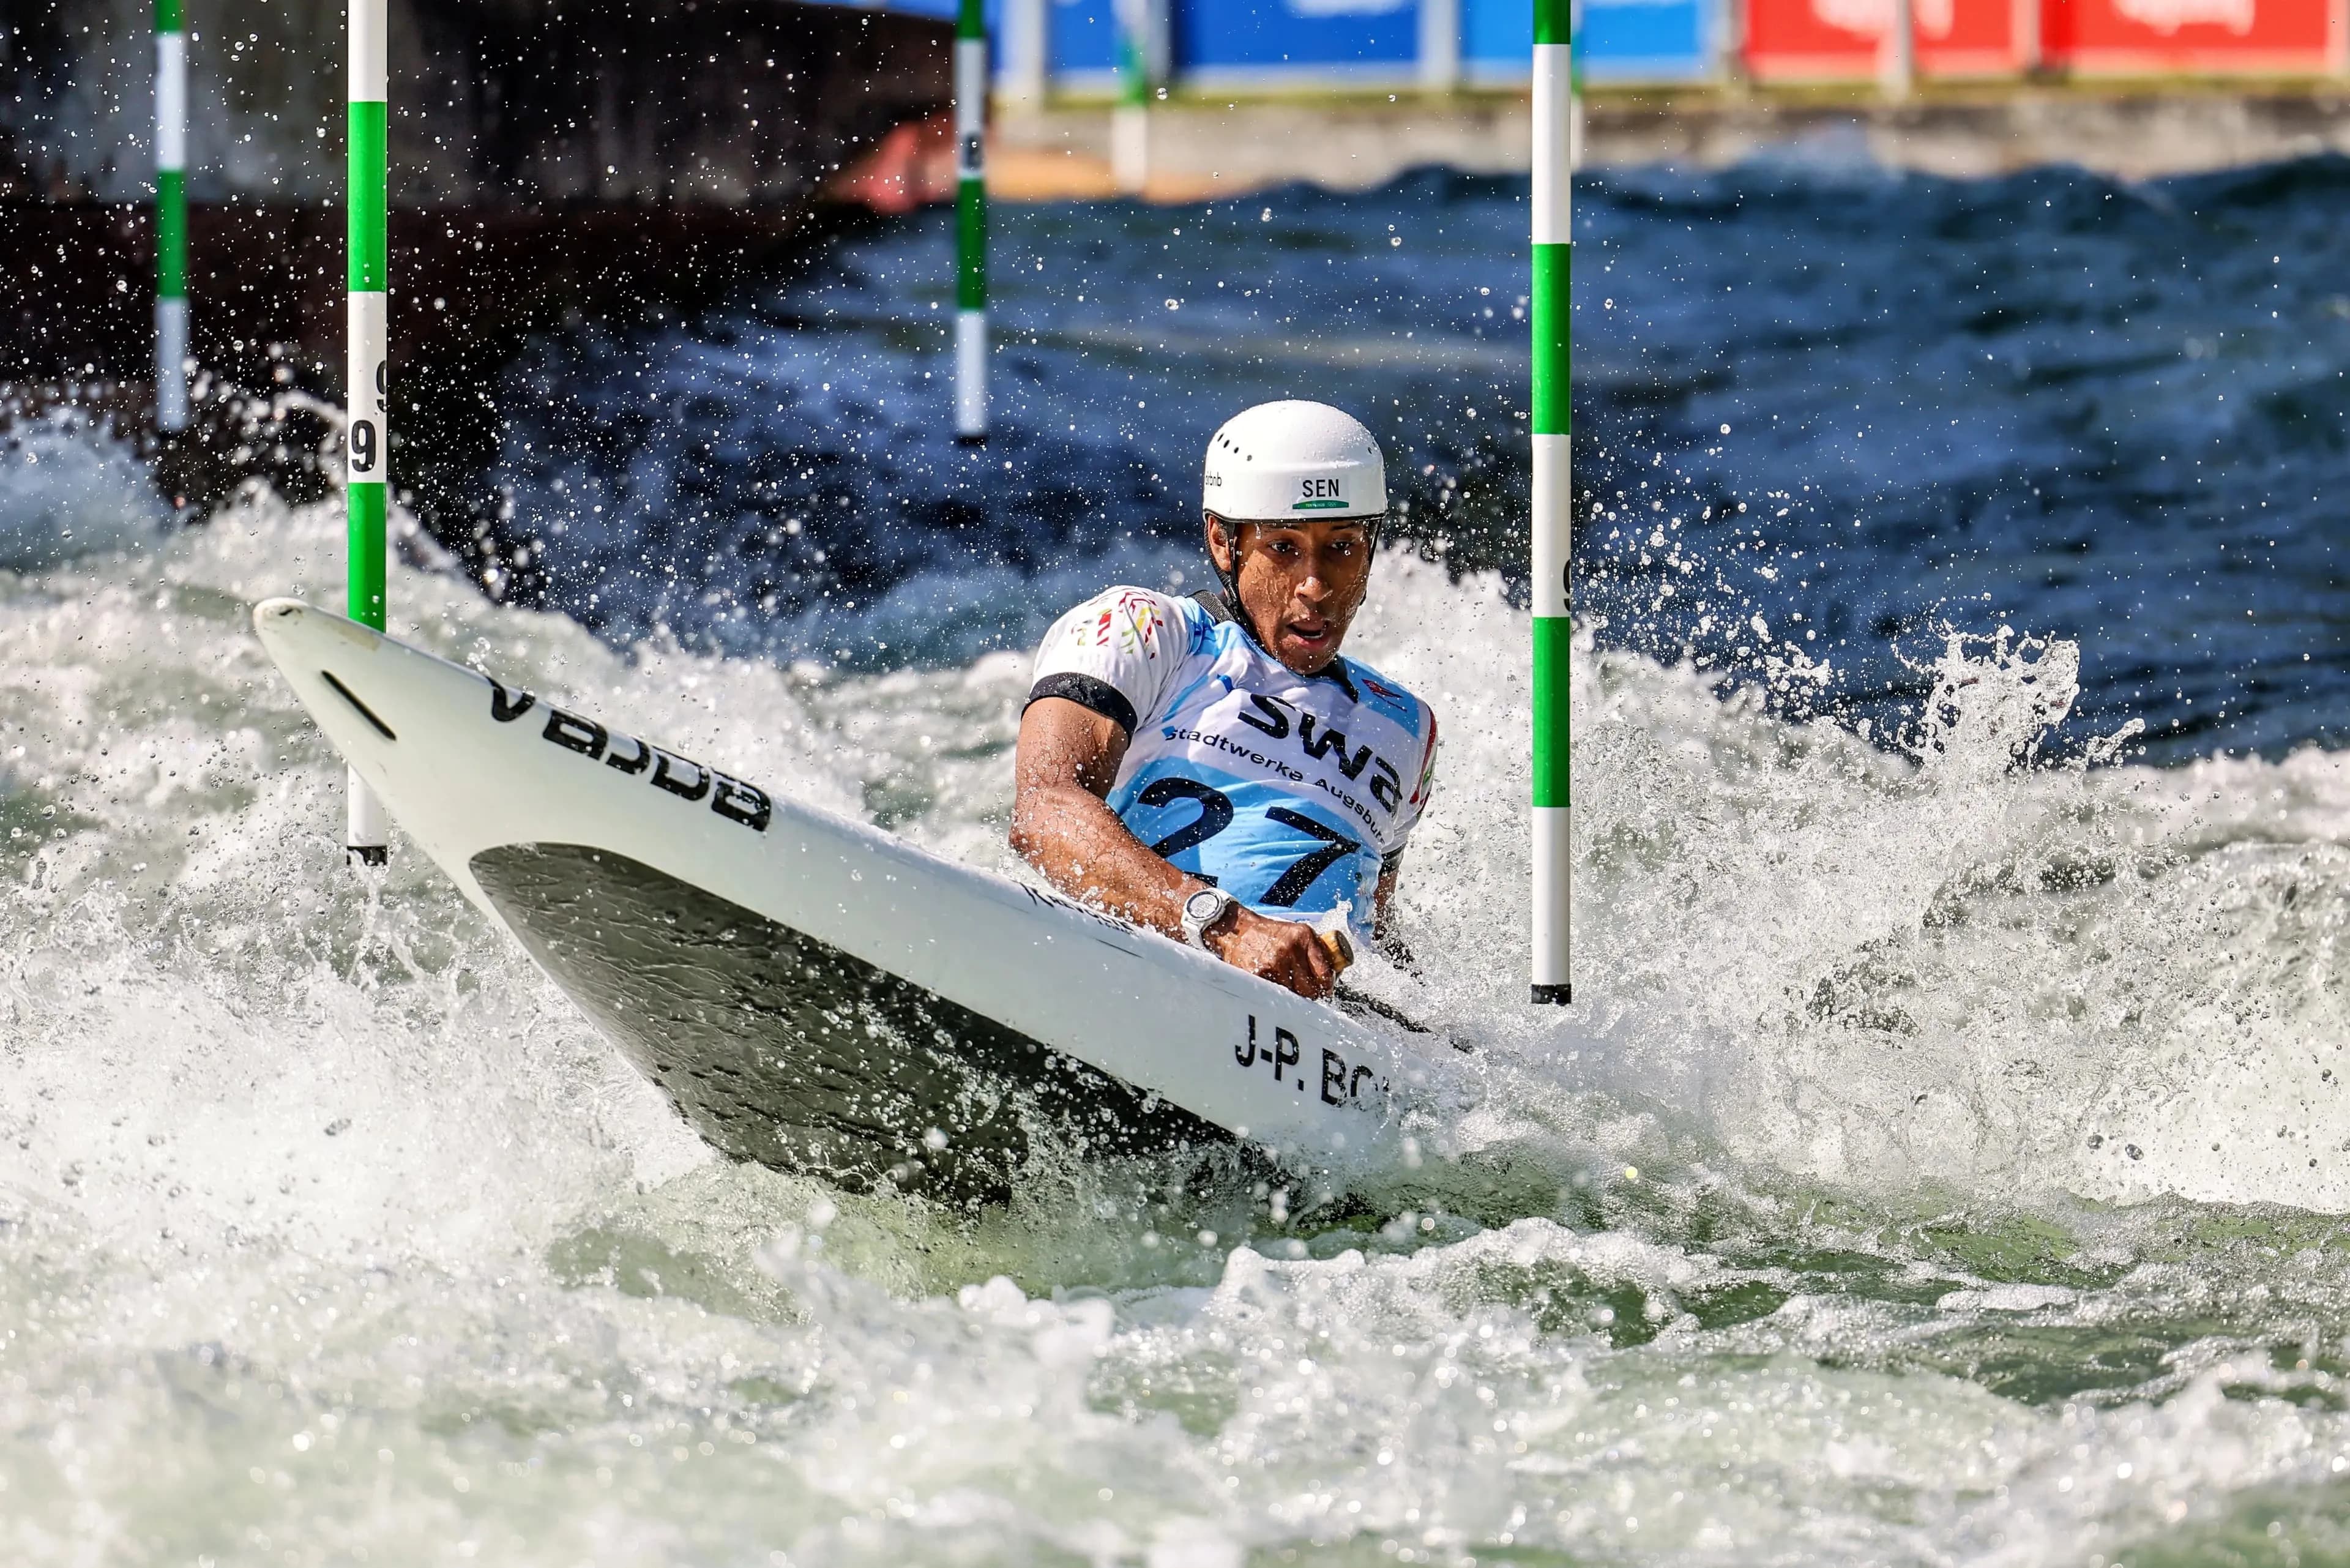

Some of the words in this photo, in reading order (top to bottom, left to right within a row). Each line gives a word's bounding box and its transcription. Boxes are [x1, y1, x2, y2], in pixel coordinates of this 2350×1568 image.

[351, 419, 376, 472] 9
[1302, 479, 1339, 498] SEN
[1137, 777, 1361, 908] 27
